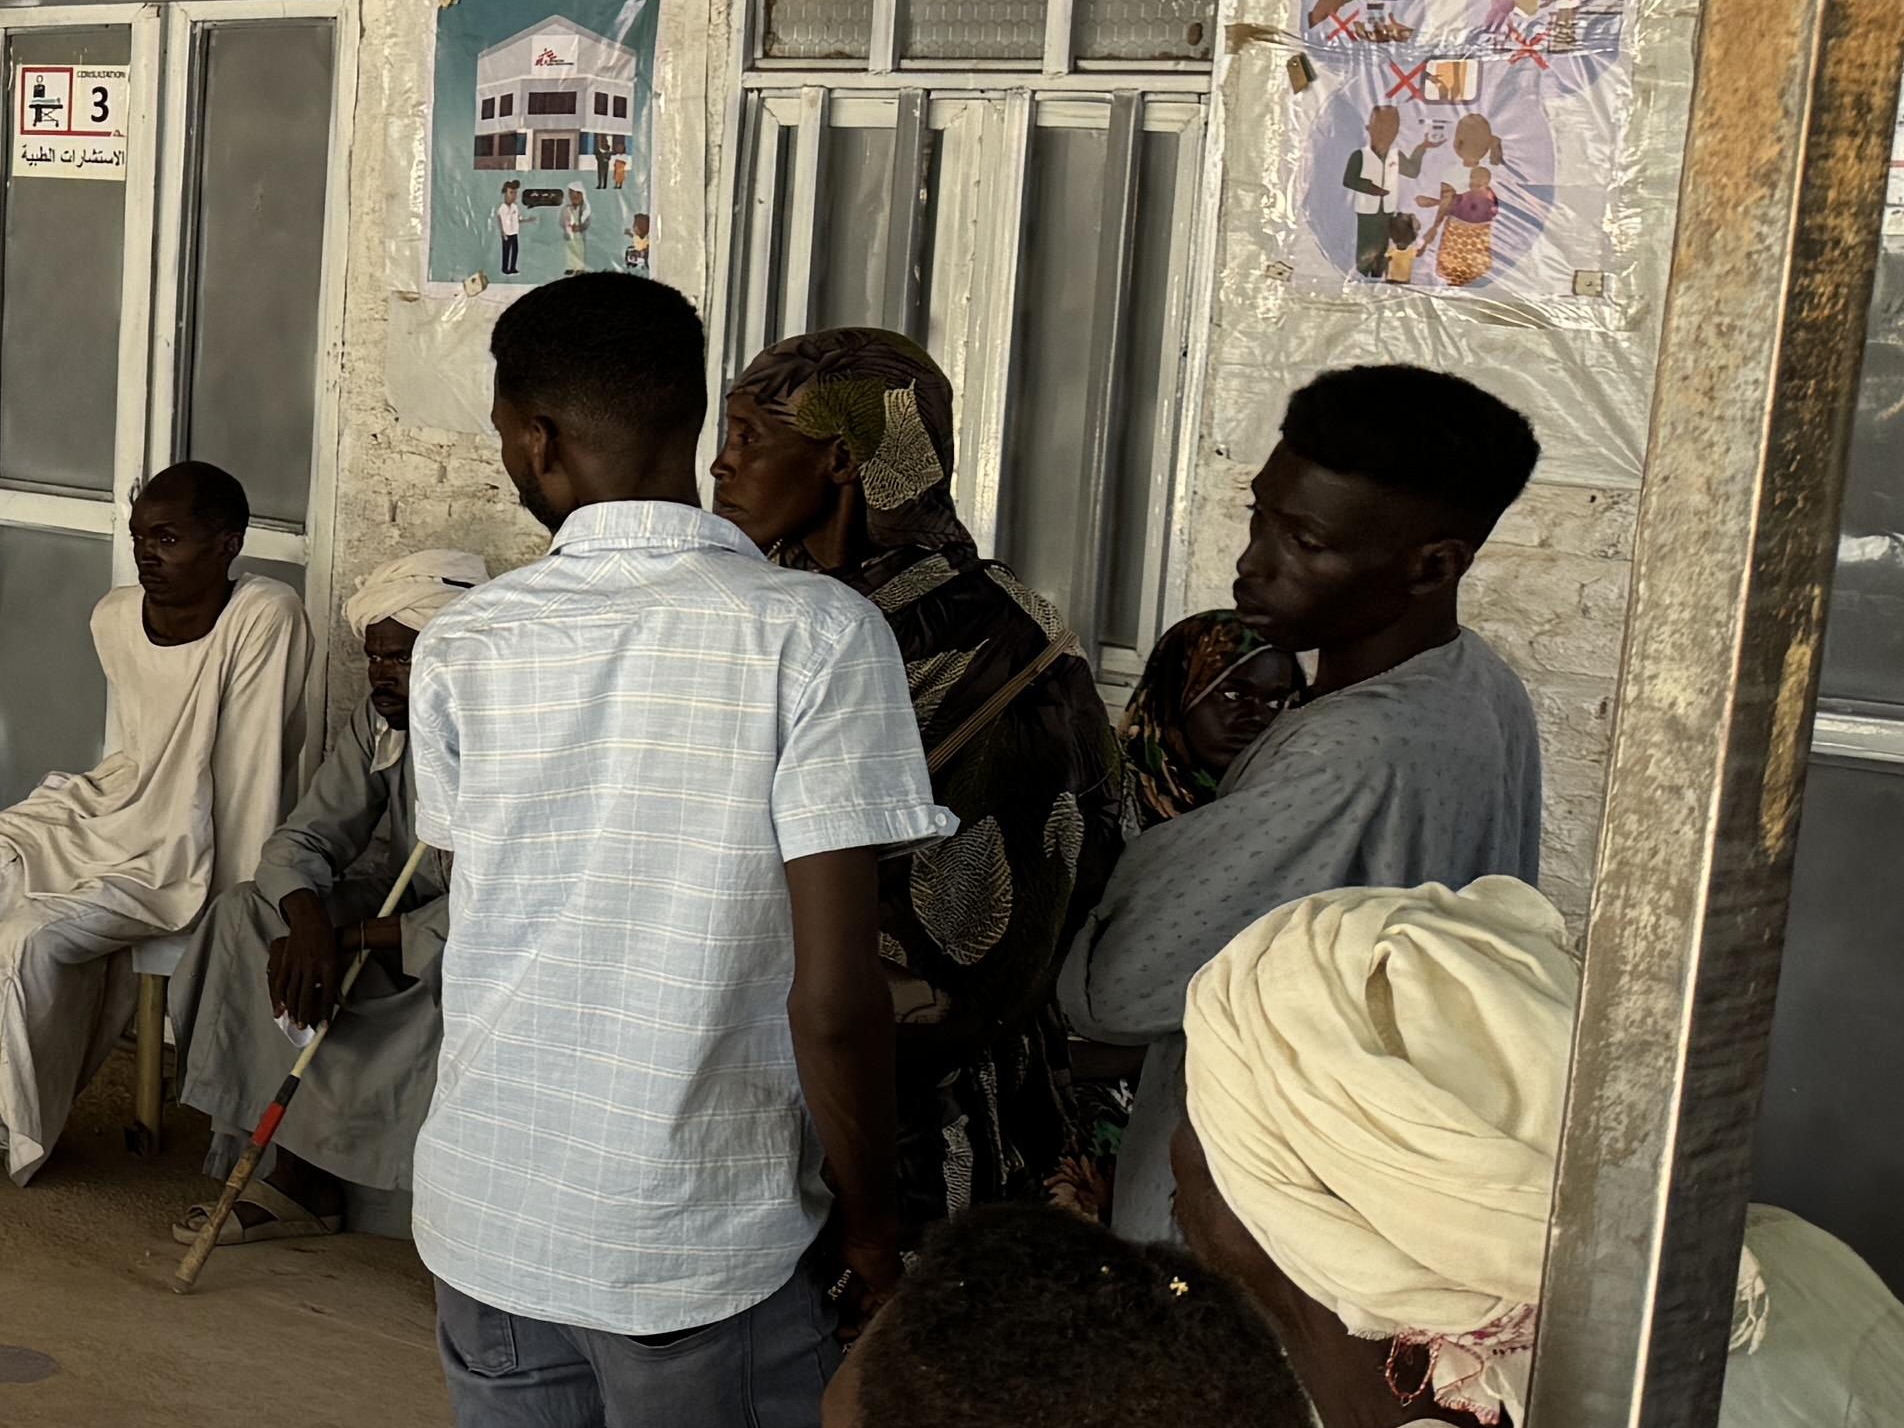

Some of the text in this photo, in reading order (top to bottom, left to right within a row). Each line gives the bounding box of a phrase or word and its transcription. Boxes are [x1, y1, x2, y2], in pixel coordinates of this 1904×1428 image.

[90, 85, 110, 123] 3
[20, 143, 126, 169] الاستشارات الطبية
